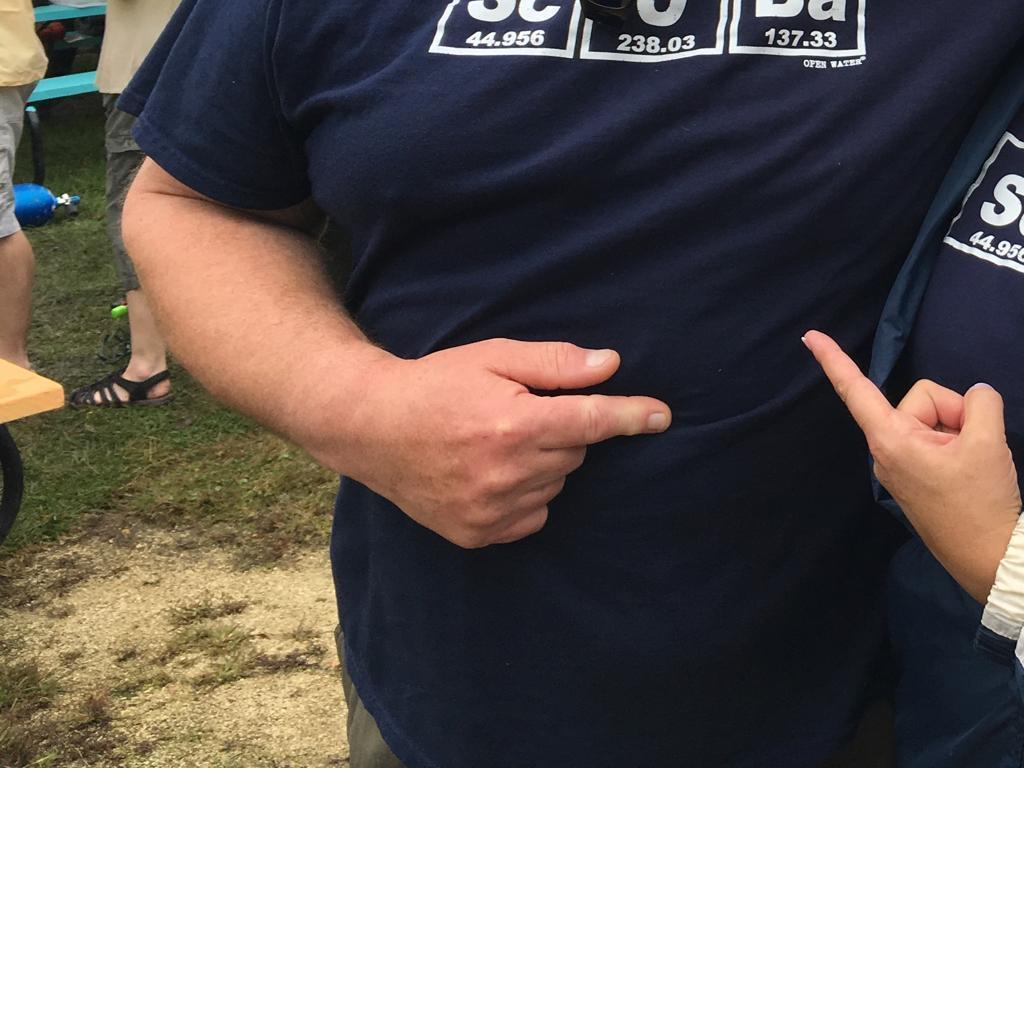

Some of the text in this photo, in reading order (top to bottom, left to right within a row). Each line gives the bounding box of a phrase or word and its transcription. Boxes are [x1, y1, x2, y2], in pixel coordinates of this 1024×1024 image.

[465, 30, 546, 47] 44.956
[616, 33, 697, 53] 238.03
[764, 28, 838, 48] 137.33
[803, 59, 827, 69] OPEN
